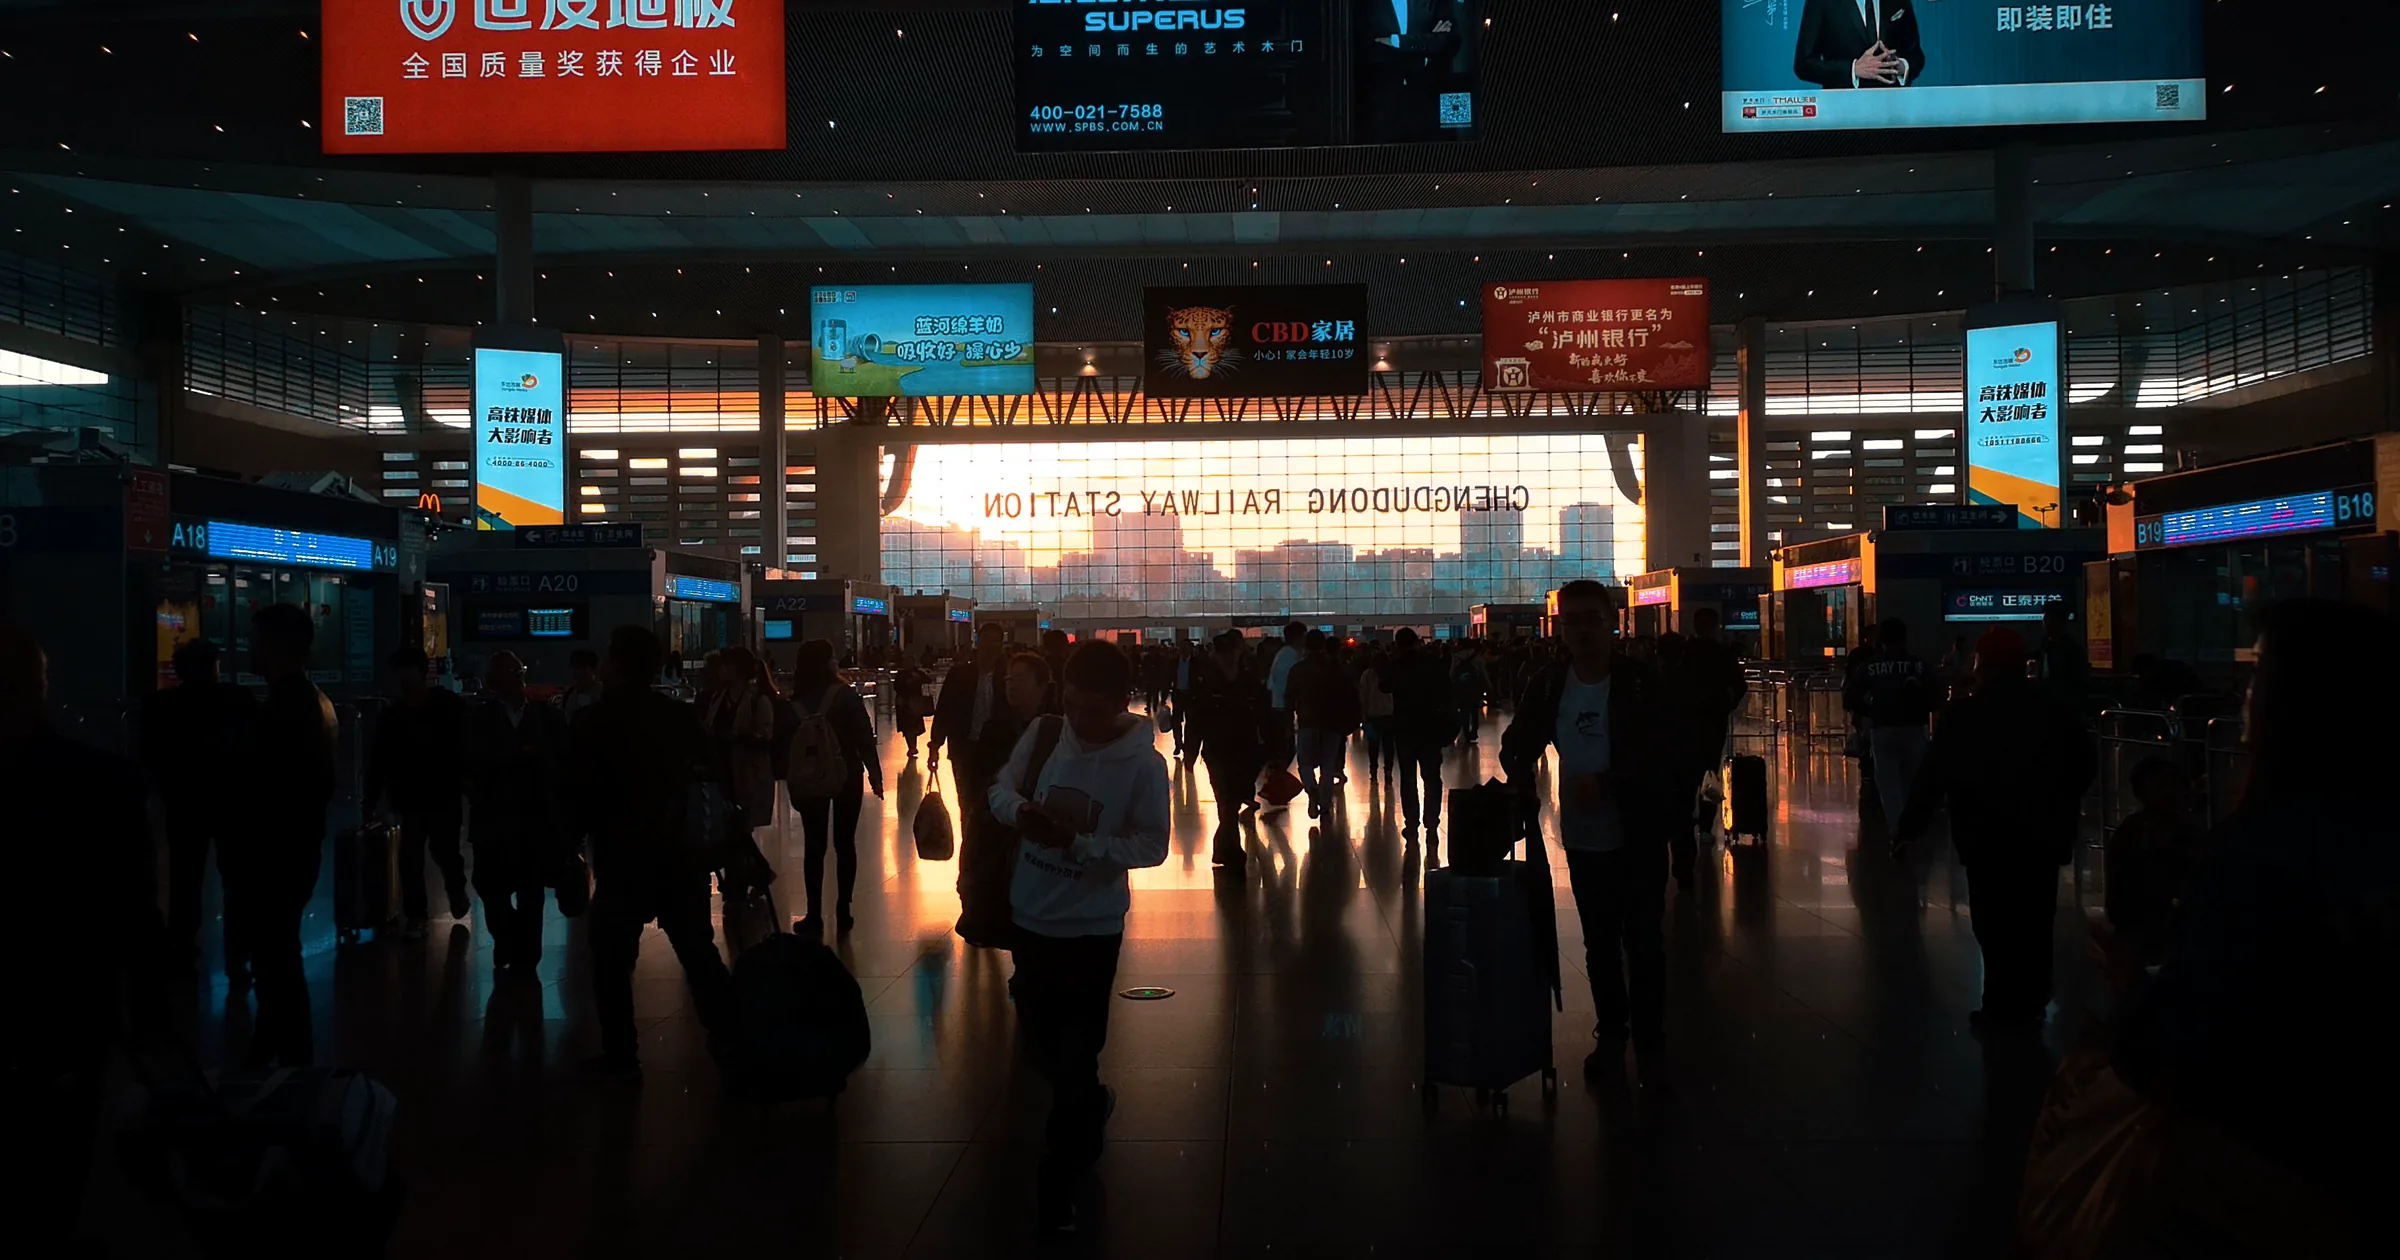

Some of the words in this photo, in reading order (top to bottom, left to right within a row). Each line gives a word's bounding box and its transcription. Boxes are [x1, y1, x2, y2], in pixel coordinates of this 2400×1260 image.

[1085, 9, 1245, 31] SUPERUS
[1997, 3, 2114, 32] 即装即住
[1031, 40, 1303, 57] 为空间而生的艺术木门
[402, 49, 737, 80] 全国质量奖获得企业
[1030, 104, 1163, 120] 400-021-7588
[1030, 121, 1163, 133] WWW.SPBS.COM.CN
[915, 316, 1003, 335] 蓝河绵羊奶
[1528, 308, 1672, 324] 泸州市商业银行更名为
[897, 342, 956, 361] 吸收好
[965, 341, 1023, 361] 操心少
[1979, 381, 2047, 402] 高铁媒体
[487, 406, 553, 425] 高铁媒体
[1979, 403, 2048, 424] 大影响者
[488, 427, 553, 445] 大影响者
[2337, 491, 2374, 521] B18
[172, 522, 206, 549] A18
[2137, 522, 2162, 544] B19
[374, 545, 397, 568] A19
[2023, 555, 2065, 573] B20
[538, 574, 578, 592] A20
[775, 598, 807, 611] A22
[1867, 660, 1895, 676] STAY
